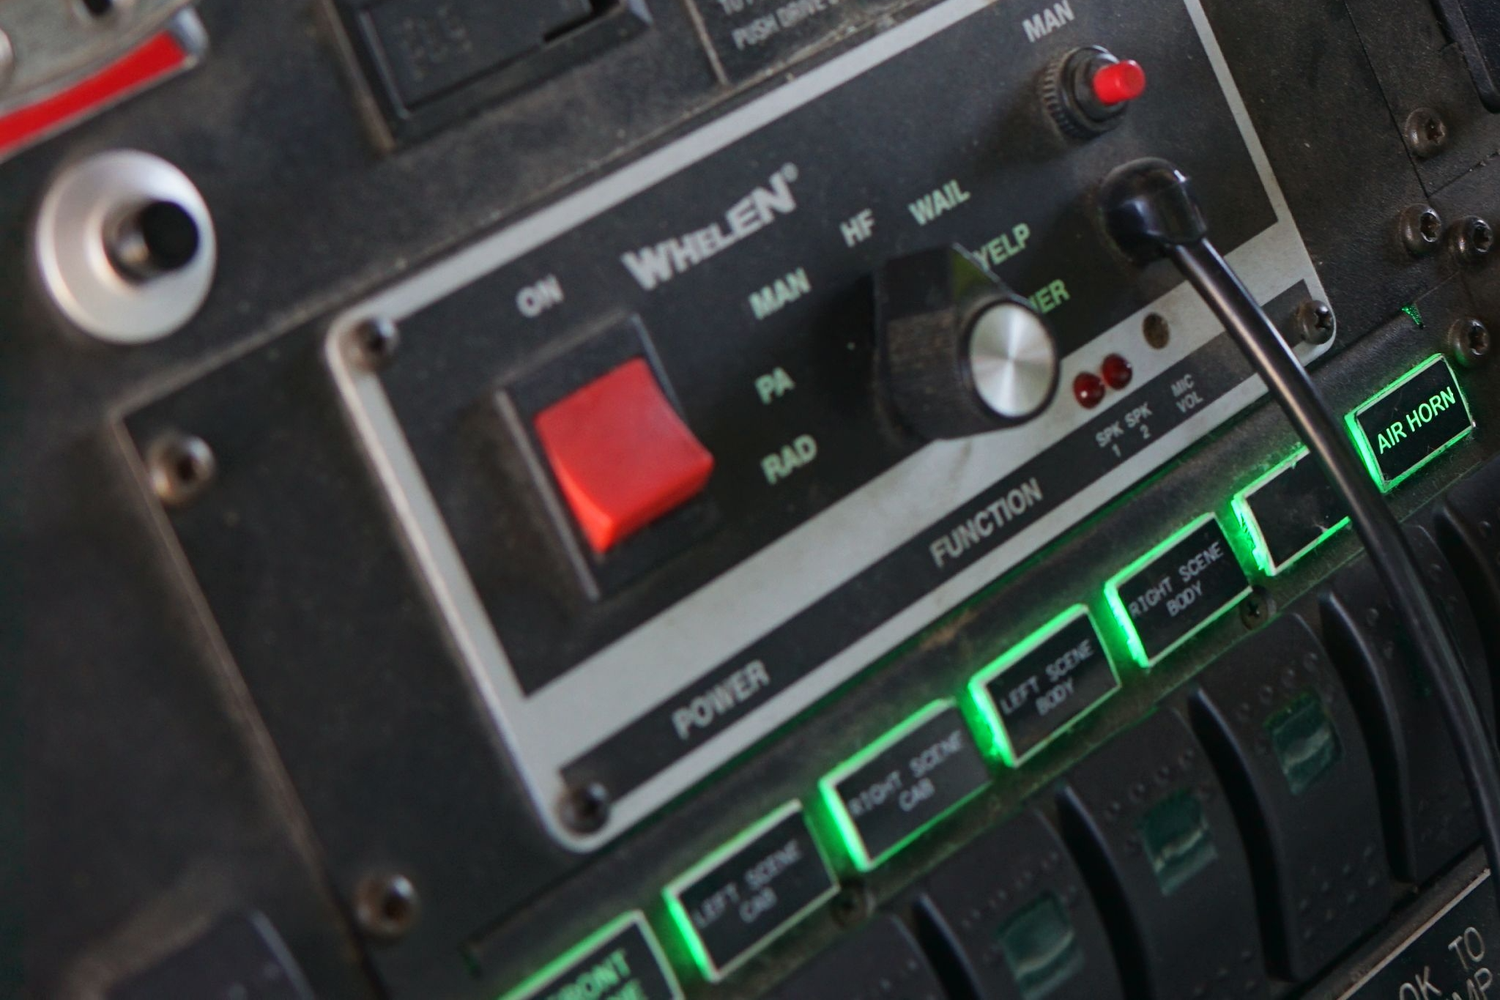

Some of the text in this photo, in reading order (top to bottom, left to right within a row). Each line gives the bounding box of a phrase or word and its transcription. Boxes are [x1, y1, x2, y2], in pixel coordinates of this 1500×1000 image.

[731, 13, 780, 50] PUSH
[1022, 0, 1075, 43] MAN
[907, 178, 971, 227] WAIL
[840, 208, 877, 248] HF
[972, 222, 1032, 275] YELP
[516, 274, 564, 318] ON
[748, 267, 812, 320] MAN
[1028, 278, 1071, 317] IER
[755, 367, 795, 404] PA
[1170, 373, 1195, 398] MIC
[1175, 391, 1204, 413] VOL
[1095, 401, 1153, 448] SPK SPK
[1139, 423, 1151, 440] 2
[1375, 386, 1457, 455] AIR HORN
[760, 435, 818, 484] RAD
[929, 477, 1043, 567] FUNCTION
[1128, 540, 1224, 619] RIGHT SCENE
[1165, 580, 1203, 617] BODY
[671, 659, 771, 741] POWER
[1001, 639, 1093, 715] LEFT SCENE
[1035, 678, 1075, 716] BODY
[849, 730, 964, 817] RIGHT SCENE
[691, 838, 801, 929] LEFT SCENE
[1447, 925, 1486, 972] TO
[546, 947, 631, 1000] RONT
